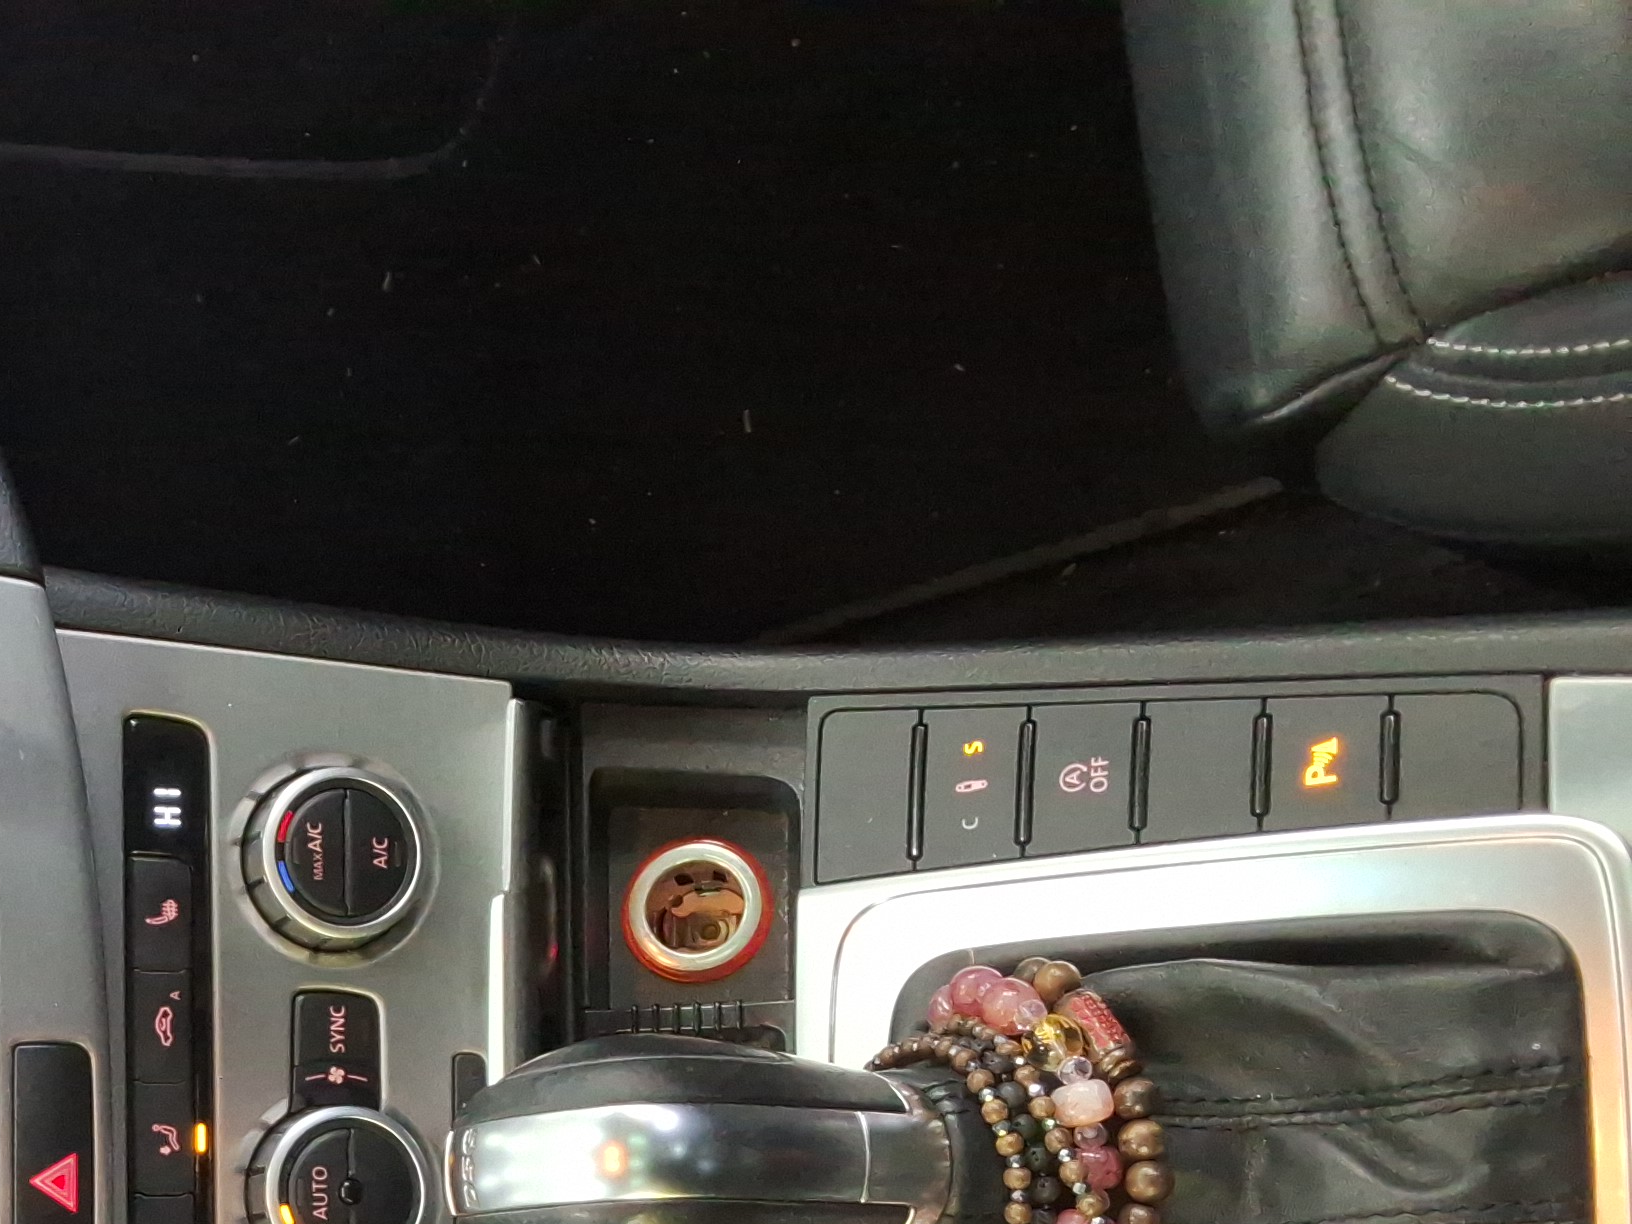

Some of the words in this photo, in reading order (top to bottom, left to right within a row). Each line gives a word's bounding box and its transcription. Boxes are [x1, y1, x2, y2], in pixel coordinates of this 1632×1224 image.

[962, 740, 985, 756] S
[1089, 757, 1109, 793] OFF
[152, 787, 182, 829] HI
[371, 837, 389, 869] A/C
[329, 1006, 346, 1053] SYNC
[311, 1165, 329, 1220] AUTO
